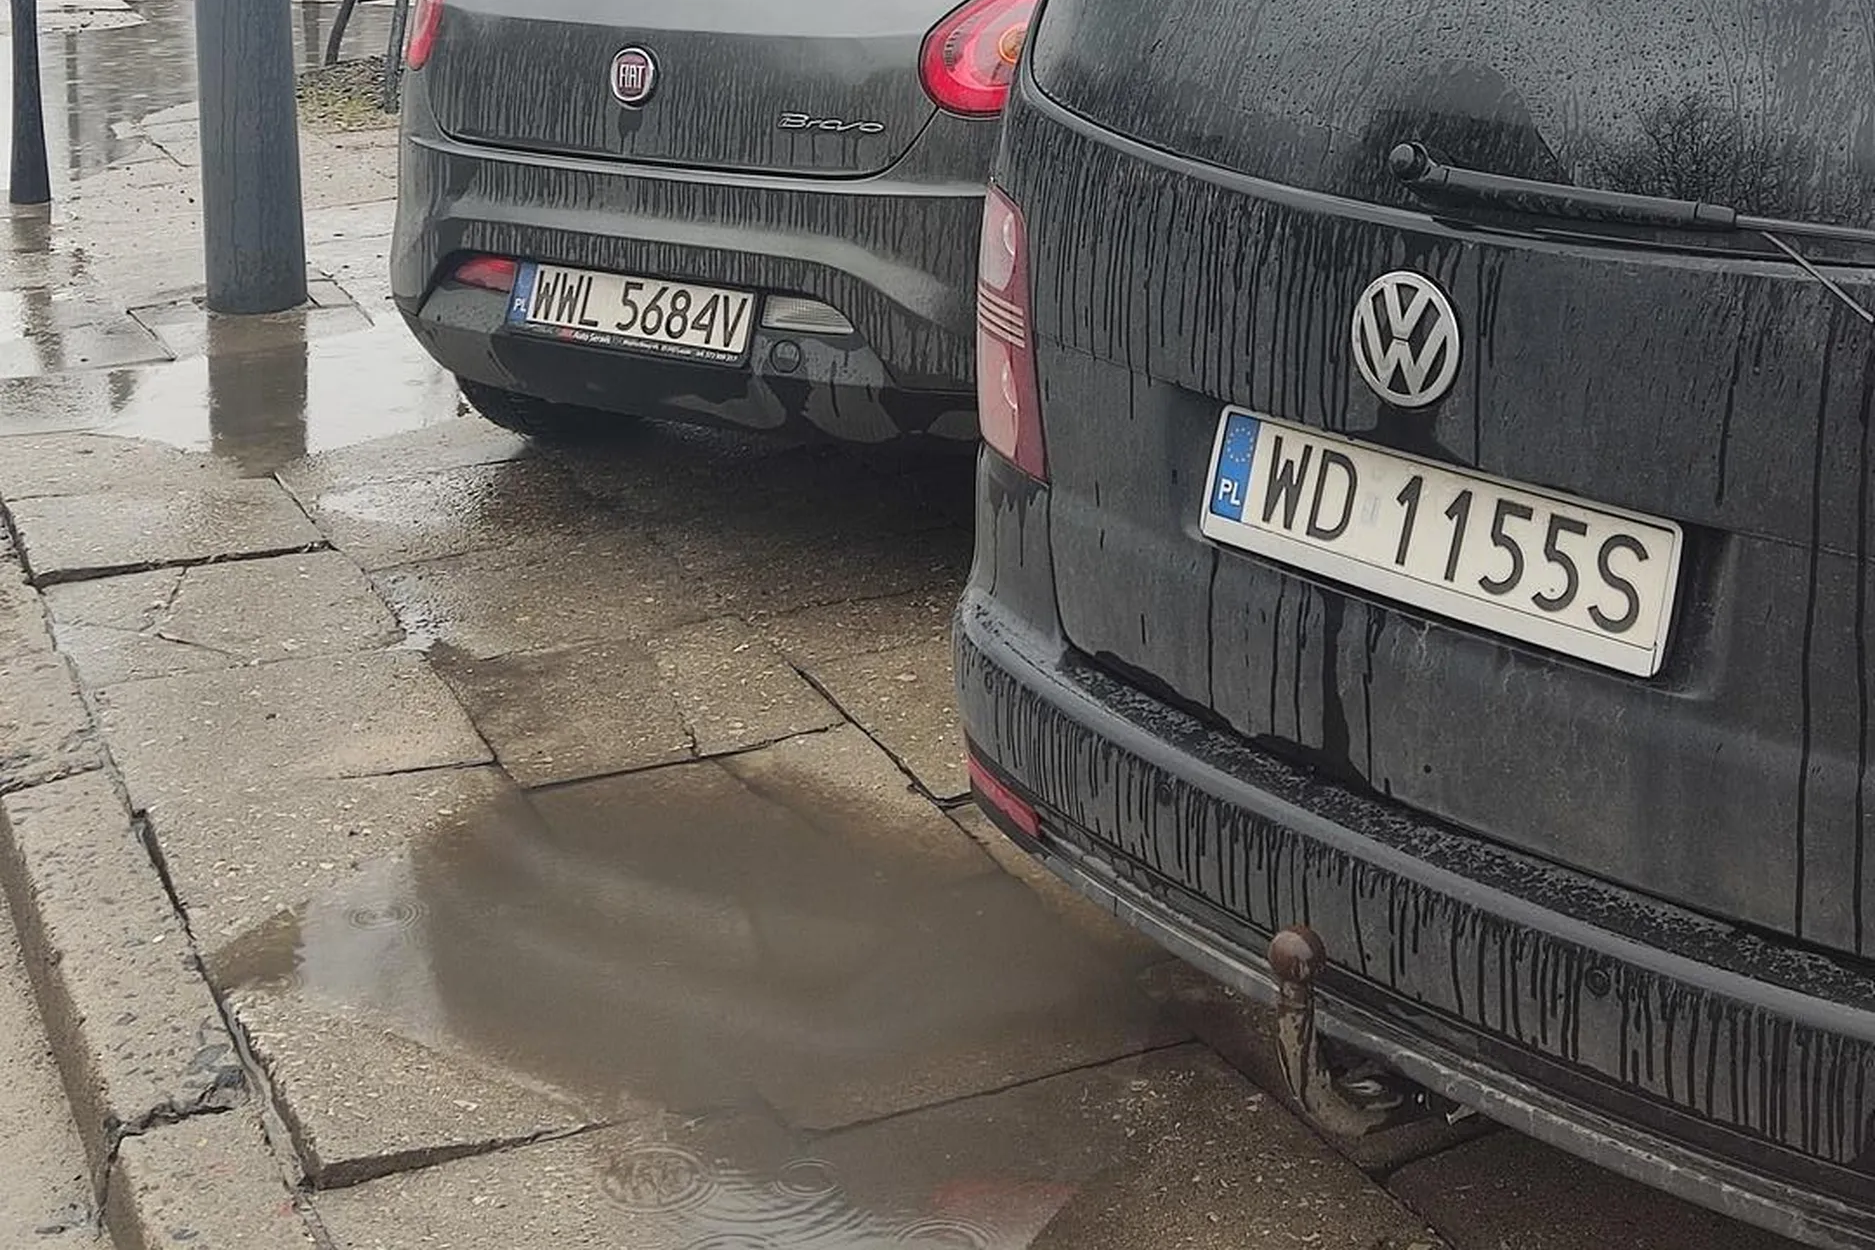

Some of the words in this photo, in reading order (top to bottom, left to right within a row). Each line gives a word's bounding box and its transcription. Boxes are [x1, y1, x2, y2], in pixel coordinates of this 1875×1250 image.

[620, 63, 646, 89] FIAT
[778, 112, 884, 133] Bravo
[513, 298, 527, 312] PL
[533, 270, 599, 328] WWL
[615, 280, 748, 348] 5684V
[1217, 478, 1242, 507] PL
[1261, 435, 1359, 542] WD
[1394, 474, 1650, 634] 1155S
